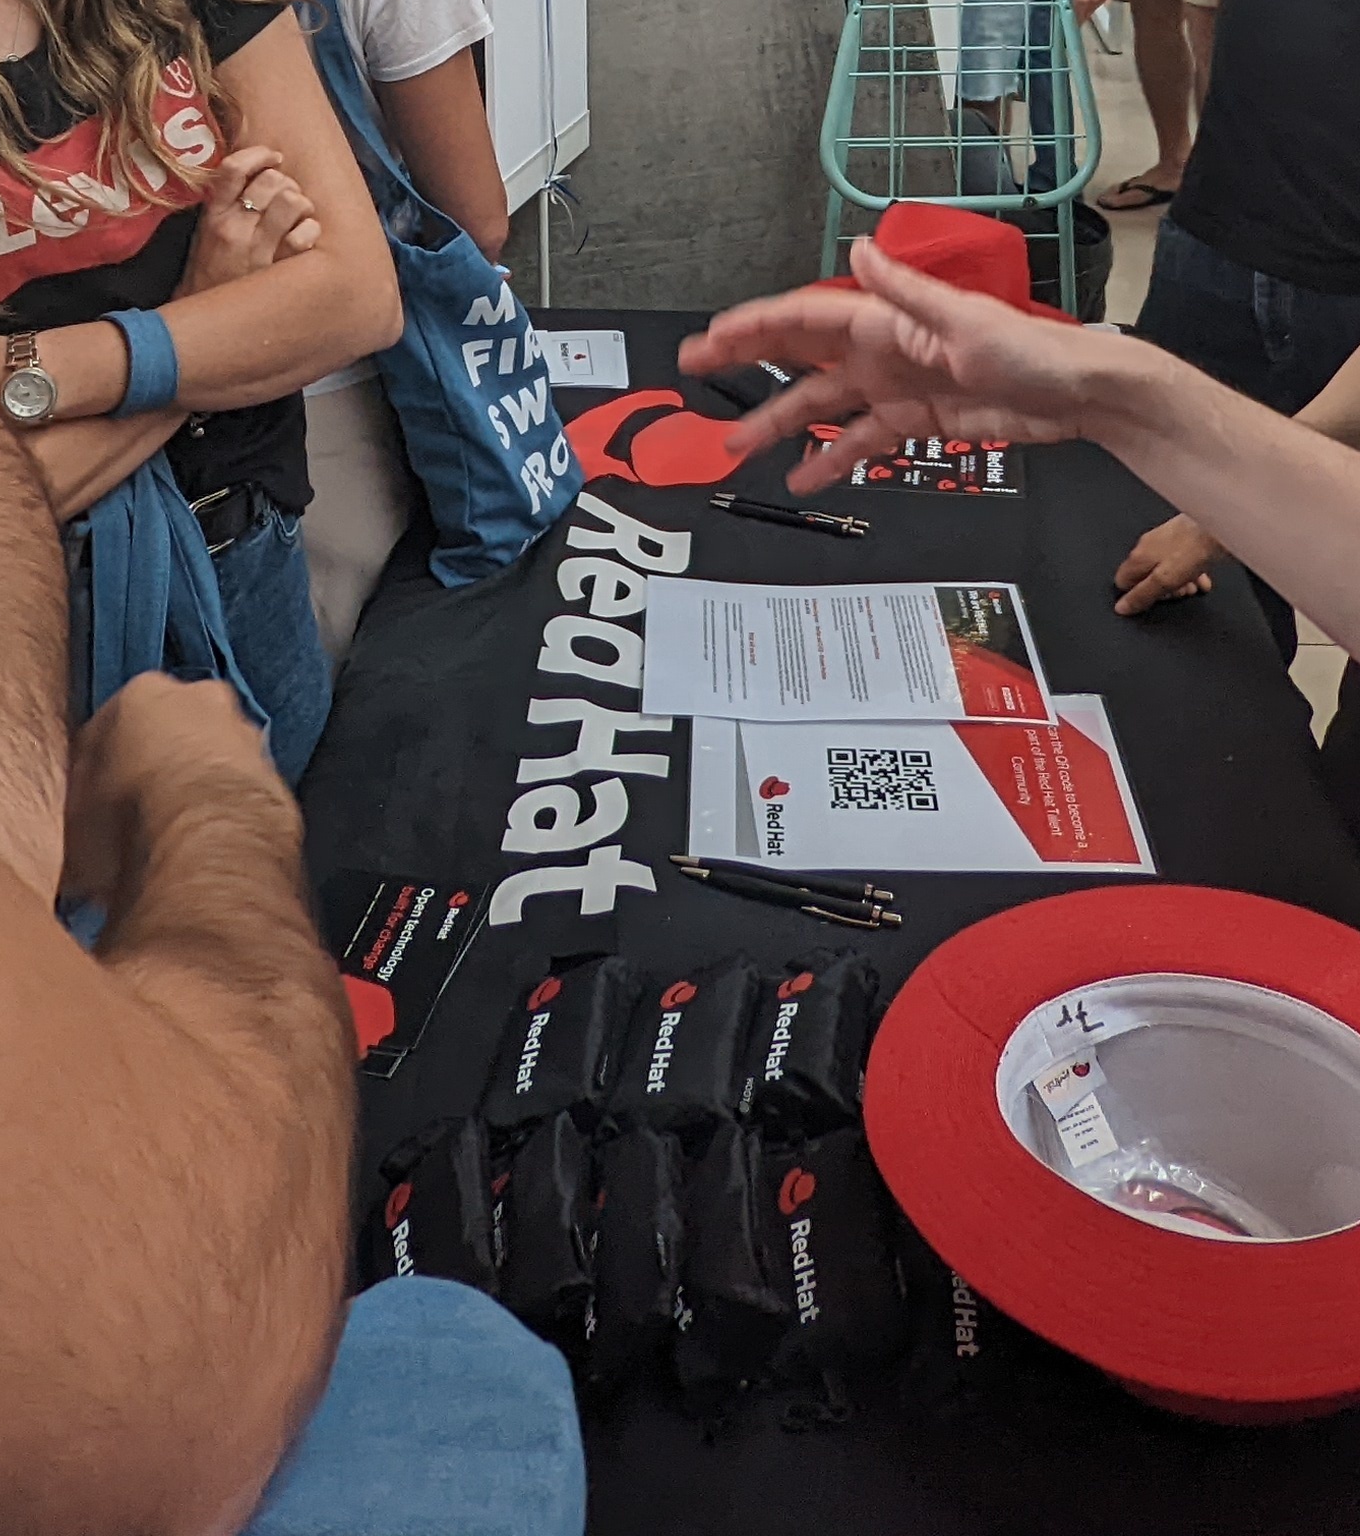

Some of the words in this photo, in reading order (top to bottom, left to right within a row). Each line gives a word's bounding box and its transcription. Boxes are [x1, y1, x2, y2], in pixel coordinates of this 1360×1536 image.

[986, 451, 1004, 467] Red
[986, 467, 1005, 484] Hat
[1023, 728, 1040, 746] part
[1030, 746, 1046, 757] of
[1051, 740, 1063, 754] the
[1033, 757, 1047, 771] the
[1055, 755, 1069, 769] QR
[1011, 755, 1031, 805] Community
[1038, 772, 1054, 791] Red
[1059, 769, 1074, 791] code
[488, 697, 674, 927] Hat
[1042, 790, 1056, 807] Hat
[1065, 793, 1076, 803] to
[766, 803, 785, 830] Red
[1067, 803, 1087, 841] become
[766, 830, 785, 856] Hat
[1077, 841, 1088, 849] a
[410, 887, 435, 918] Open
[443, 907, 460, 924] Red
[436, 923, 452, 940] Hat
[362, 927, 392, 971] change
[377, 918, 420, 982] technology
[524, 1011, 551, 1050] Red
[654, 1011, 682, 1051] Red
[772, 1002, 799, 1042] Red
[515, 1049, 540, 1095] Hat
[646, 1051, 670, 1094] Hat
[765, 1040, 790, 1082] Hat
[791, 1218, 814, 1272] Red
[794, 1268, 820, 1325] Hat
[951, 1270, 978, 1307] ed
[954, 1306, 980, 1358] Hat
